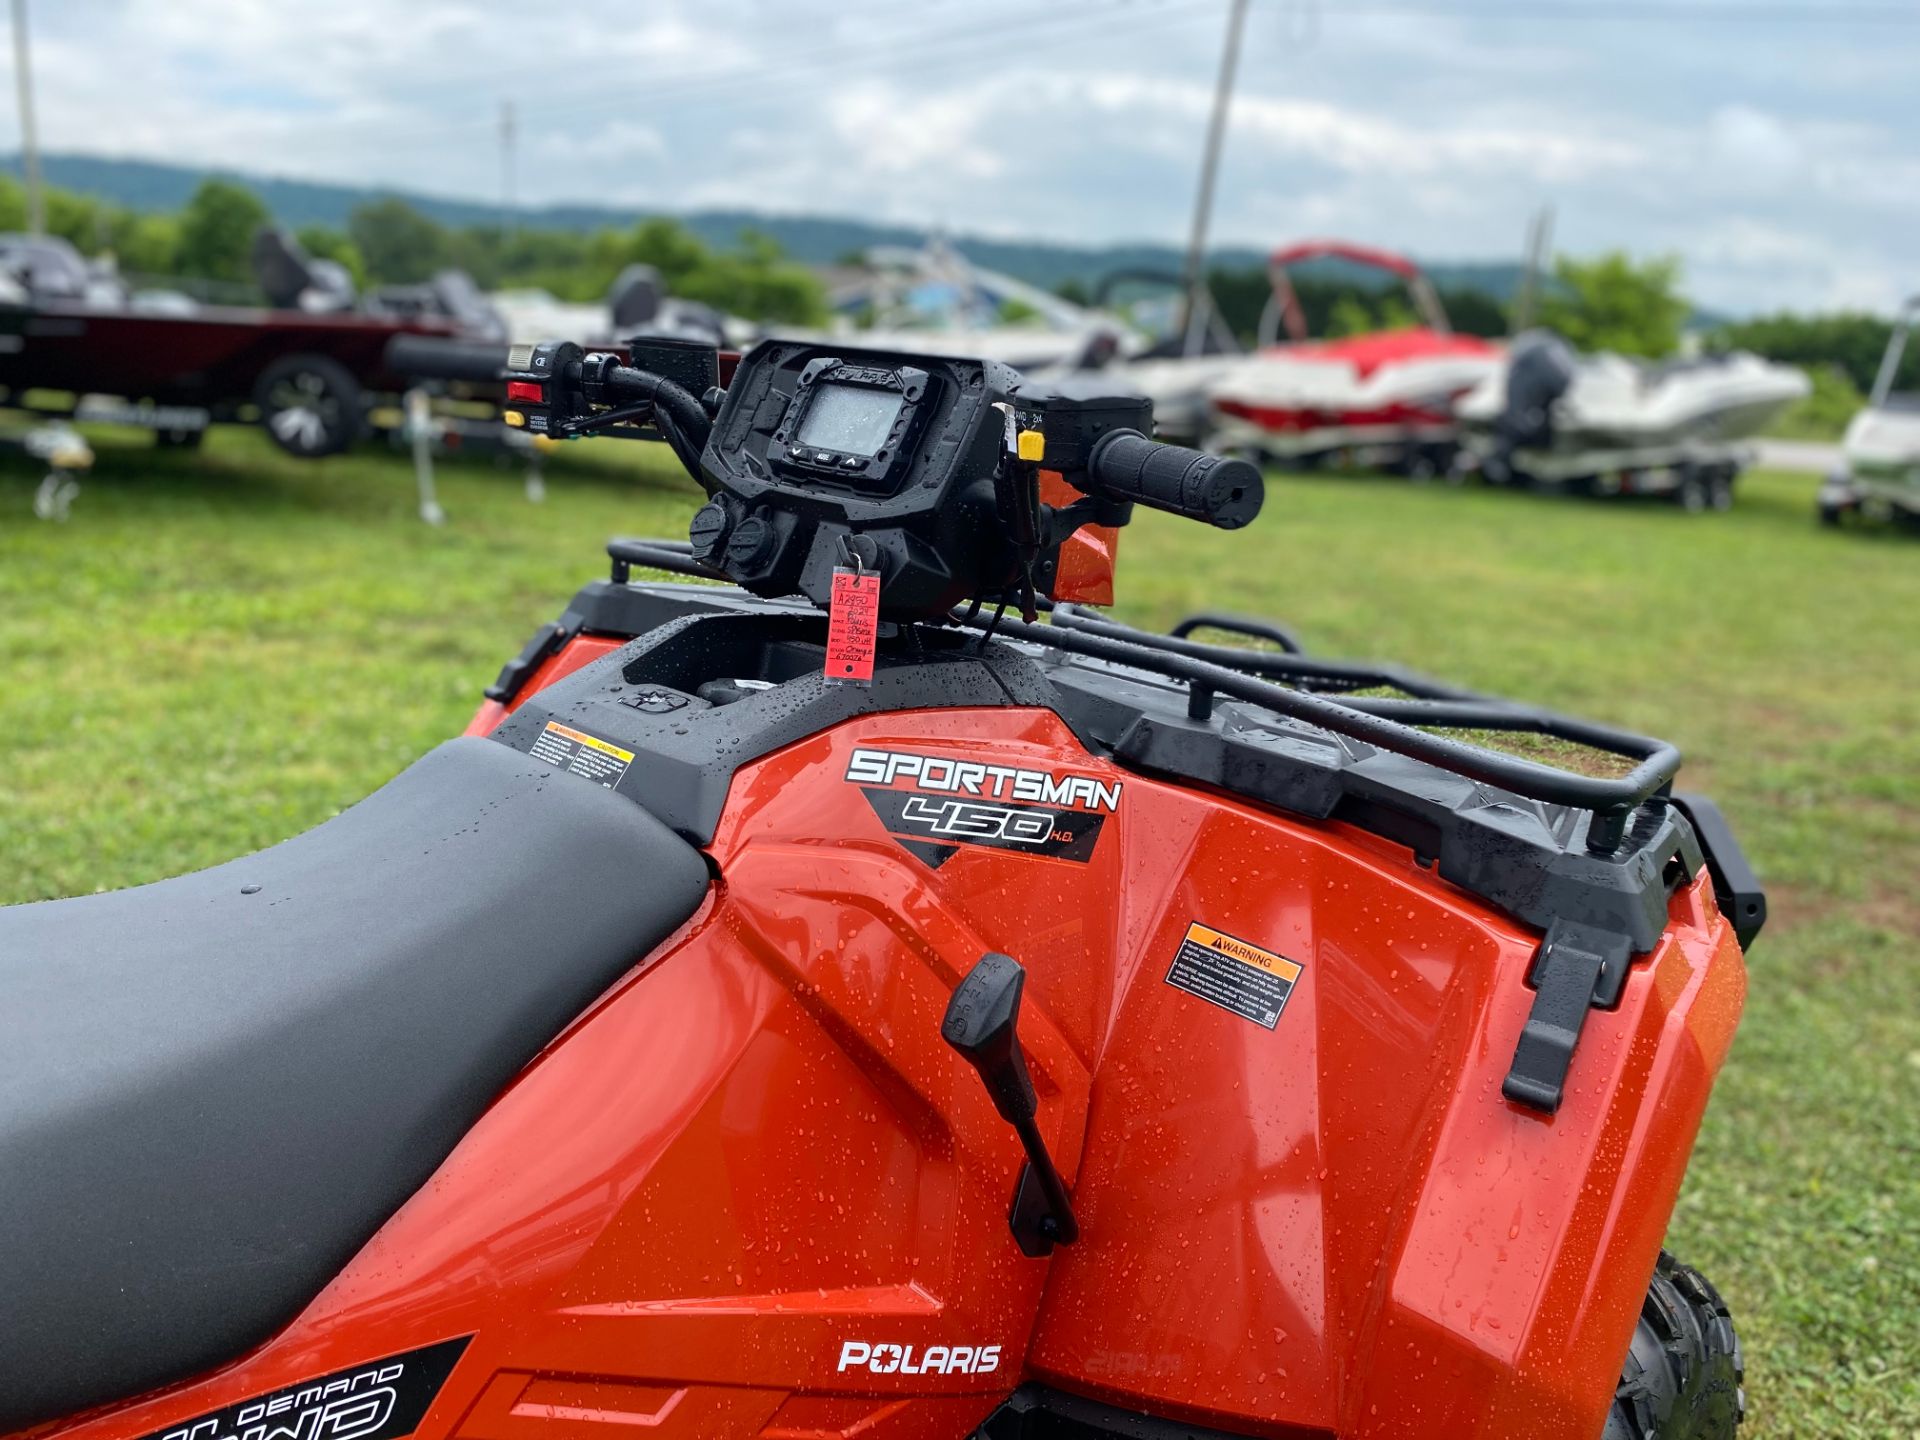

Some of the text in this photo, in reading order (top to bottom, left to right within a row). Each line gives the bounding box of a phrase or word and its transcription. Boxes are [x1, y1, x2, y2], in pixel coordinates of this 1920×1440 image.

[846, 749, 1122, 812] SPORTSMAN
[901, 796, 1055, 845] 450
[1222, 940, 1273, 969] WARNING
[837, 1341, 1002, 1374] POLARIS
[237, 1363, 404, 1426] DEMAND
